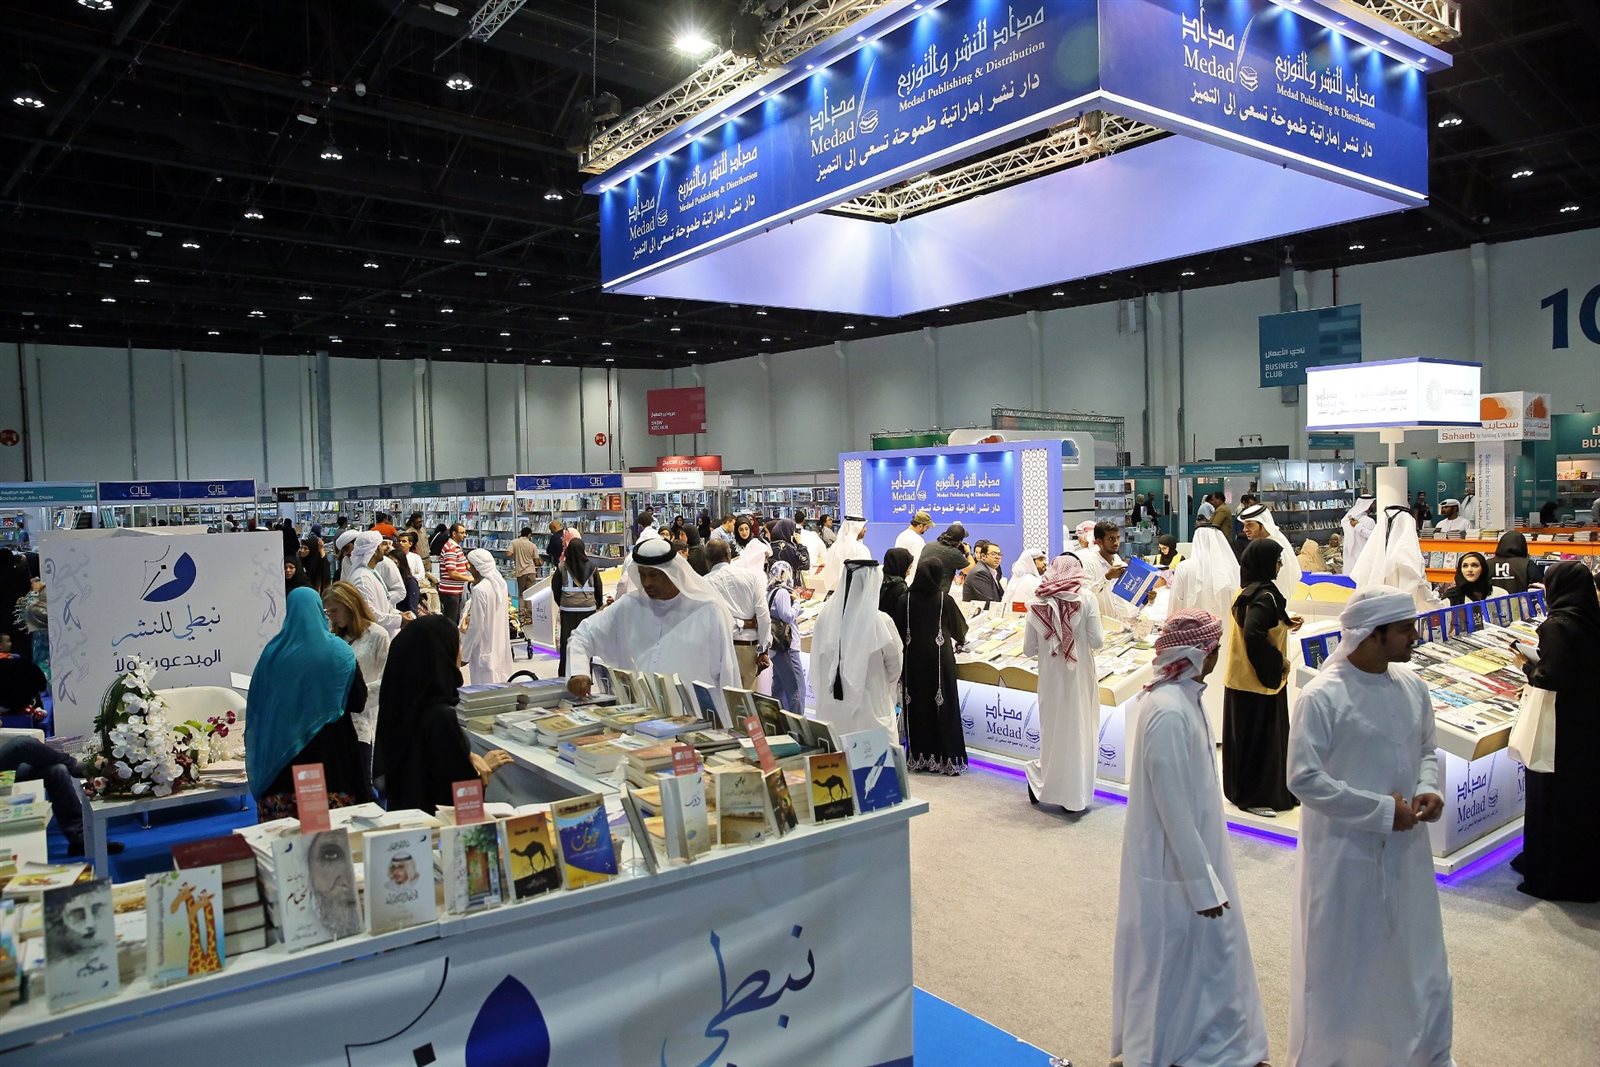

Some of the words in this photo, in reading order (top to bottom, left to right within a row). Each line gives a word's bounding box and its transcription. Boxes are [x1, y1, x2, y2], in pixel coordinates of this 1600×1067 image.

[952, 17, 987, 72] للنشر
[897, 43, 948, 98] والتوزيع
[899, 92, 926, 112] Medad
[928, 73, 973, 99] Publishing
[975, 67, 984, 77] &
[986, 41, 1045, 74] Distribution
[1183, 44, 1235, 84] Medad
[1275, 50, 1317, 90] والتوزيع
[1019, 72, 1040, 98] دار
[1190, 82, 1220, 105] التميز
[1319, 66, 1343, 96] للنشر
[940, 92, 984, 129] إماراتية
[987, 80, 1015, 112] نشر
[1223, 92, 1236, 116] إلى
[1276, 83, 1299, 101] Medad
[1300, 93, 1333, 117] Publishing
[1334, 106, 1340, 116] &
[1341, 108, 1376, 130] Distribution
[1239, 105, 1268, 121] تسعى
[1271, 107, 1307, 136] طموحة
[811, 121, 855, 158] Medad
[892, 115, 936, 145] طموحة
[1309, 121, 1340, 151] إماراتية
[1342, 136, 1359, 153] نشر
[844, 148, 856, 171] إلى
[860, 134, 889, 166] تسعى
[1361, 141, 1373, 159] دار
[708, 150, 728, 186] للنشر
[816, 153, 841, 182] التميز
[678, 164, 706, 202] والتوزيع
[679, 199, 694, 213] Medad
[695, 191, 720, 207] Publishing
[726, 171, 758, 190] Distribution
[702, 204, 726, 228] إماراتية
[728, 197, 742, 219] نشر
[744, 193, 756, 211] دار
[629, 216, 655, 241] Medad
[658, 229, 674, 251] تسعى
[676, 218, 700, 238] طموحة
[633, 240, 648, 260] التميز
[1265, 361, 1298, 371] BUSINESS
[892, 491, 916, 501] Medad
[111, 610, 173, 647] للنشر
[172, 604, 221, 641] نبطي
[986, 720, 1022, 740] Medad
[1457, 795, 1486, 824] Medad
